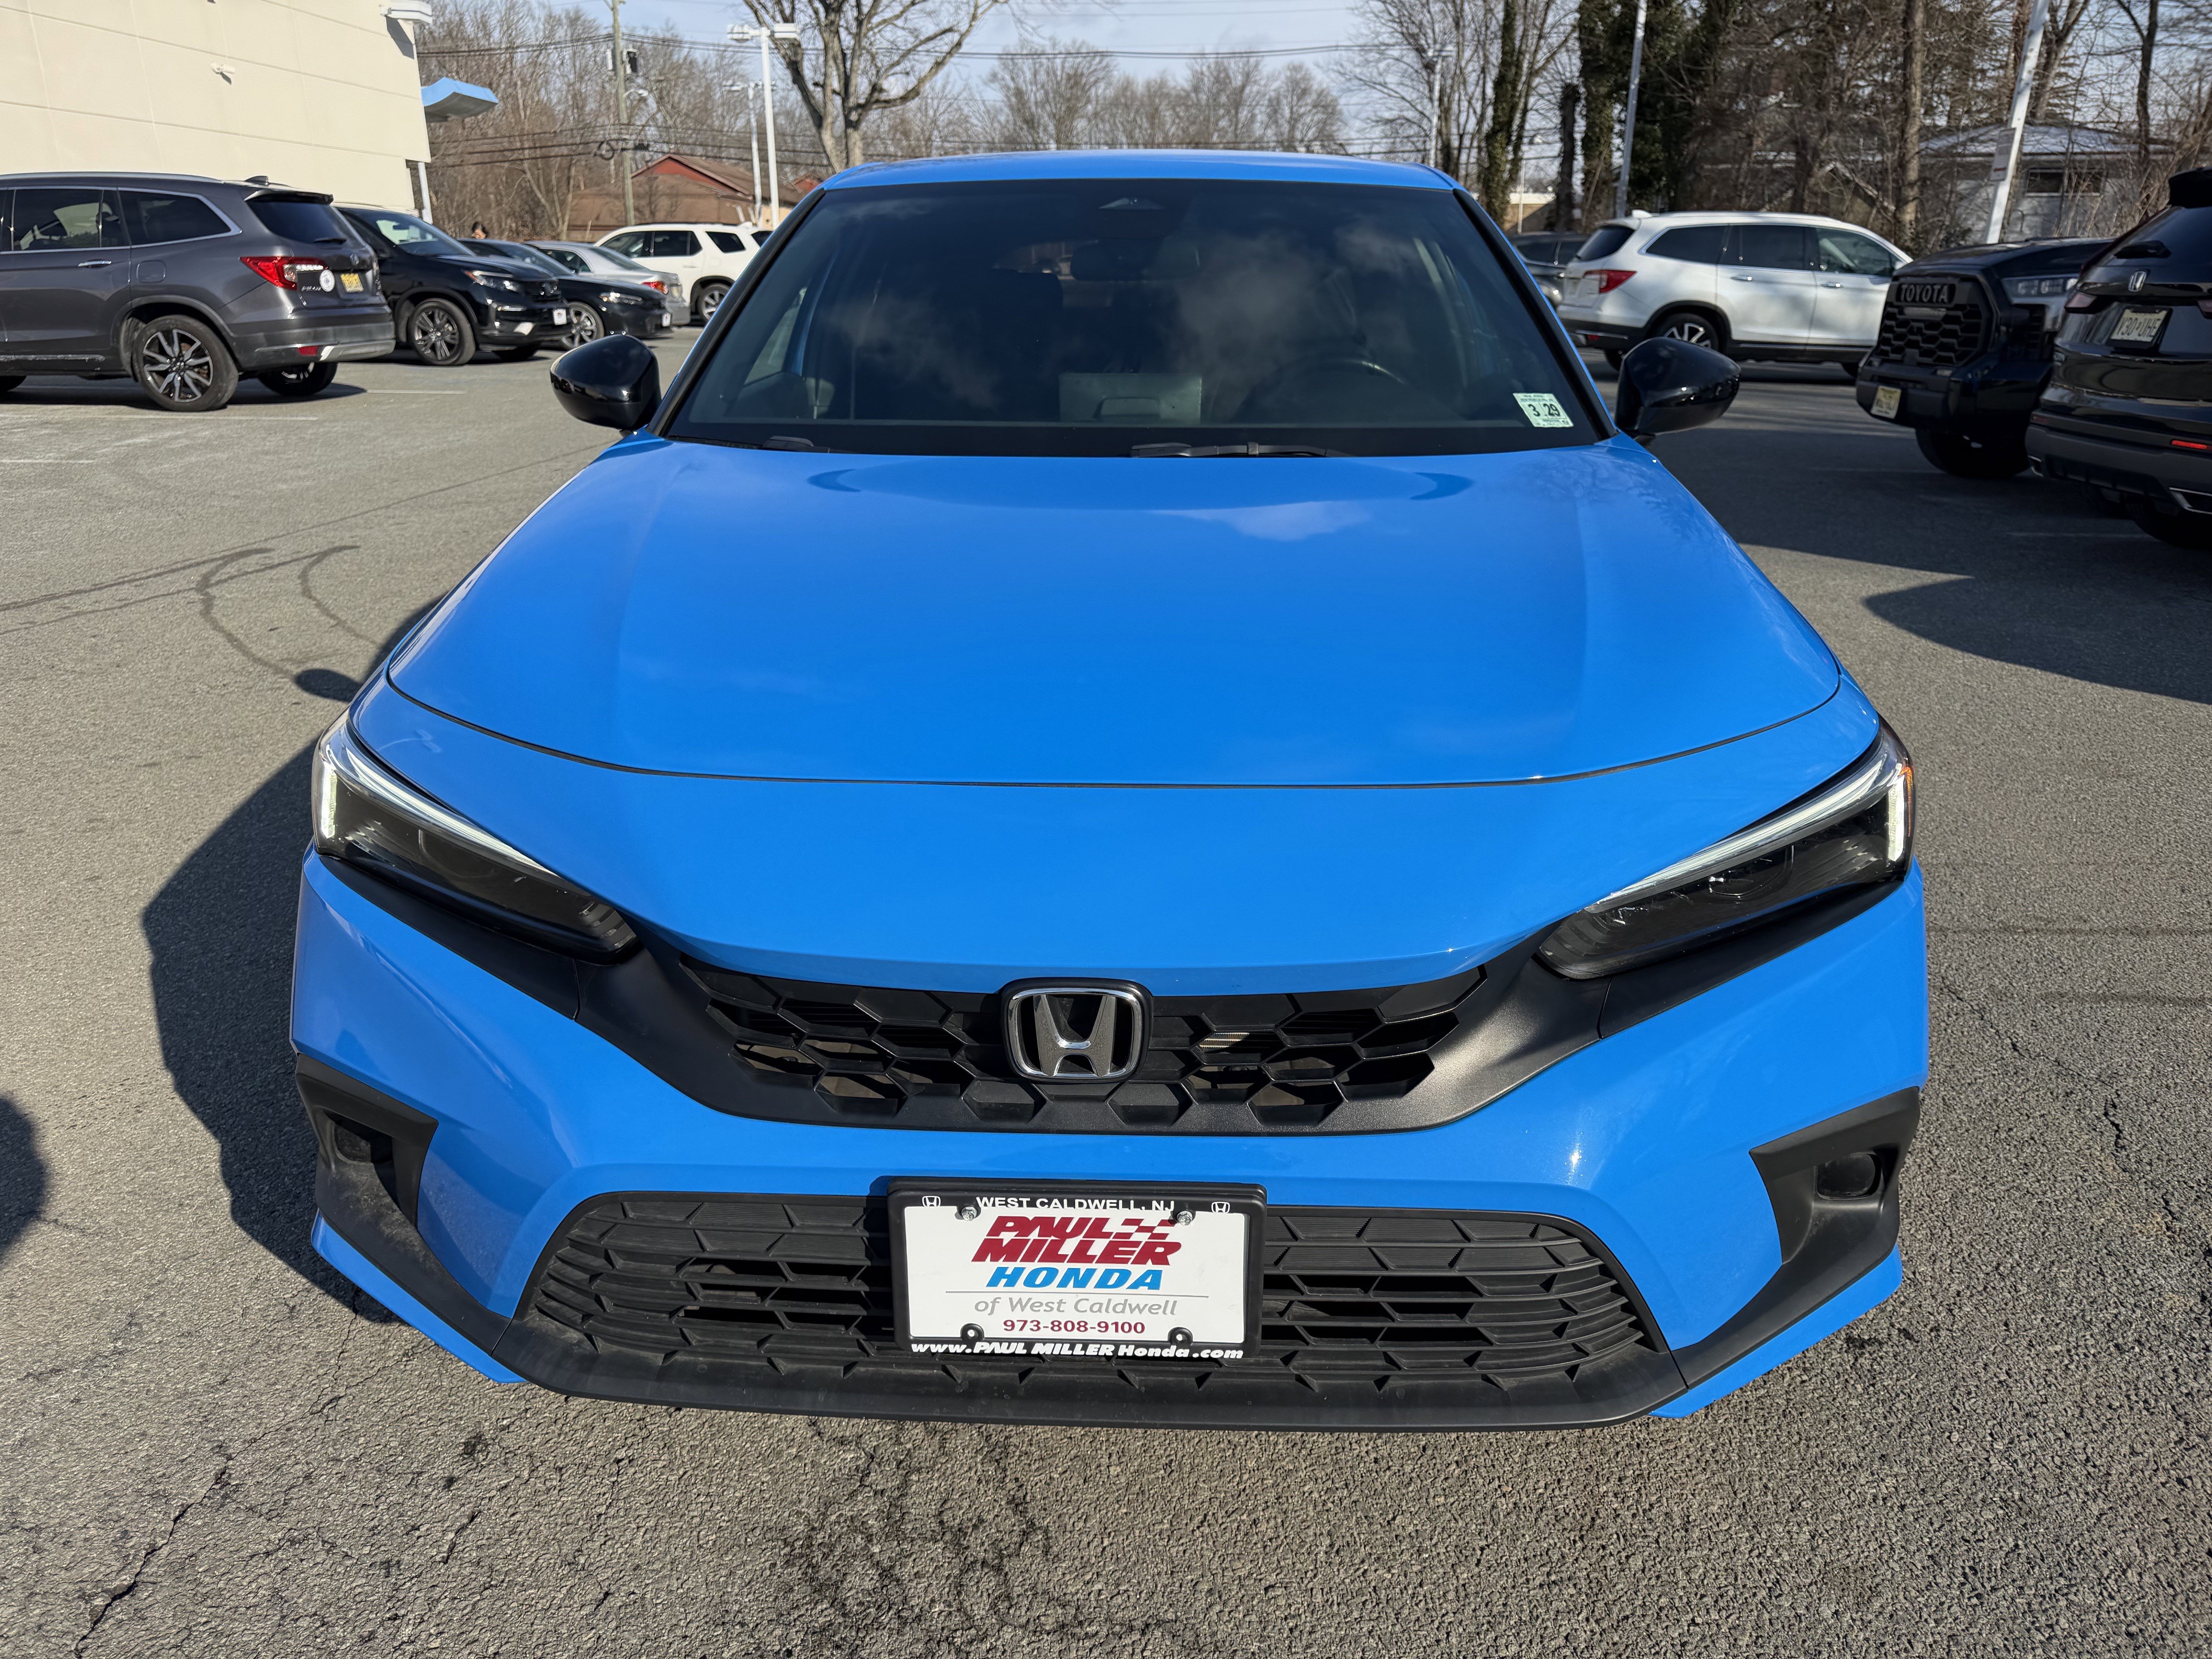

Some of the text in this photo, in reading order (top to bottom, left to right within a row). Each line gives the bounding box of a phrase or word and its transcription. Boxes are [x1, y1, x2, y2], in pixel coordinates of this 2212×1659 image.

[1901, 284, 1948, 302] TOYOTA
[1528, 404, 1540, 417] 3
[976, 1196, 1030, 1208] WEST
[1152, 1200, 1175, 1211] NJ
[986, 1216, 1114, 1239] PAUL
[971, 1238, 1182, 1266] MILLER
[986, 1267, 1163, 1290] HONDA
[974, 1297, 1177, 1316] of West Caldwell
[1003, 1319, 1145, 1334] 973-808-9100
